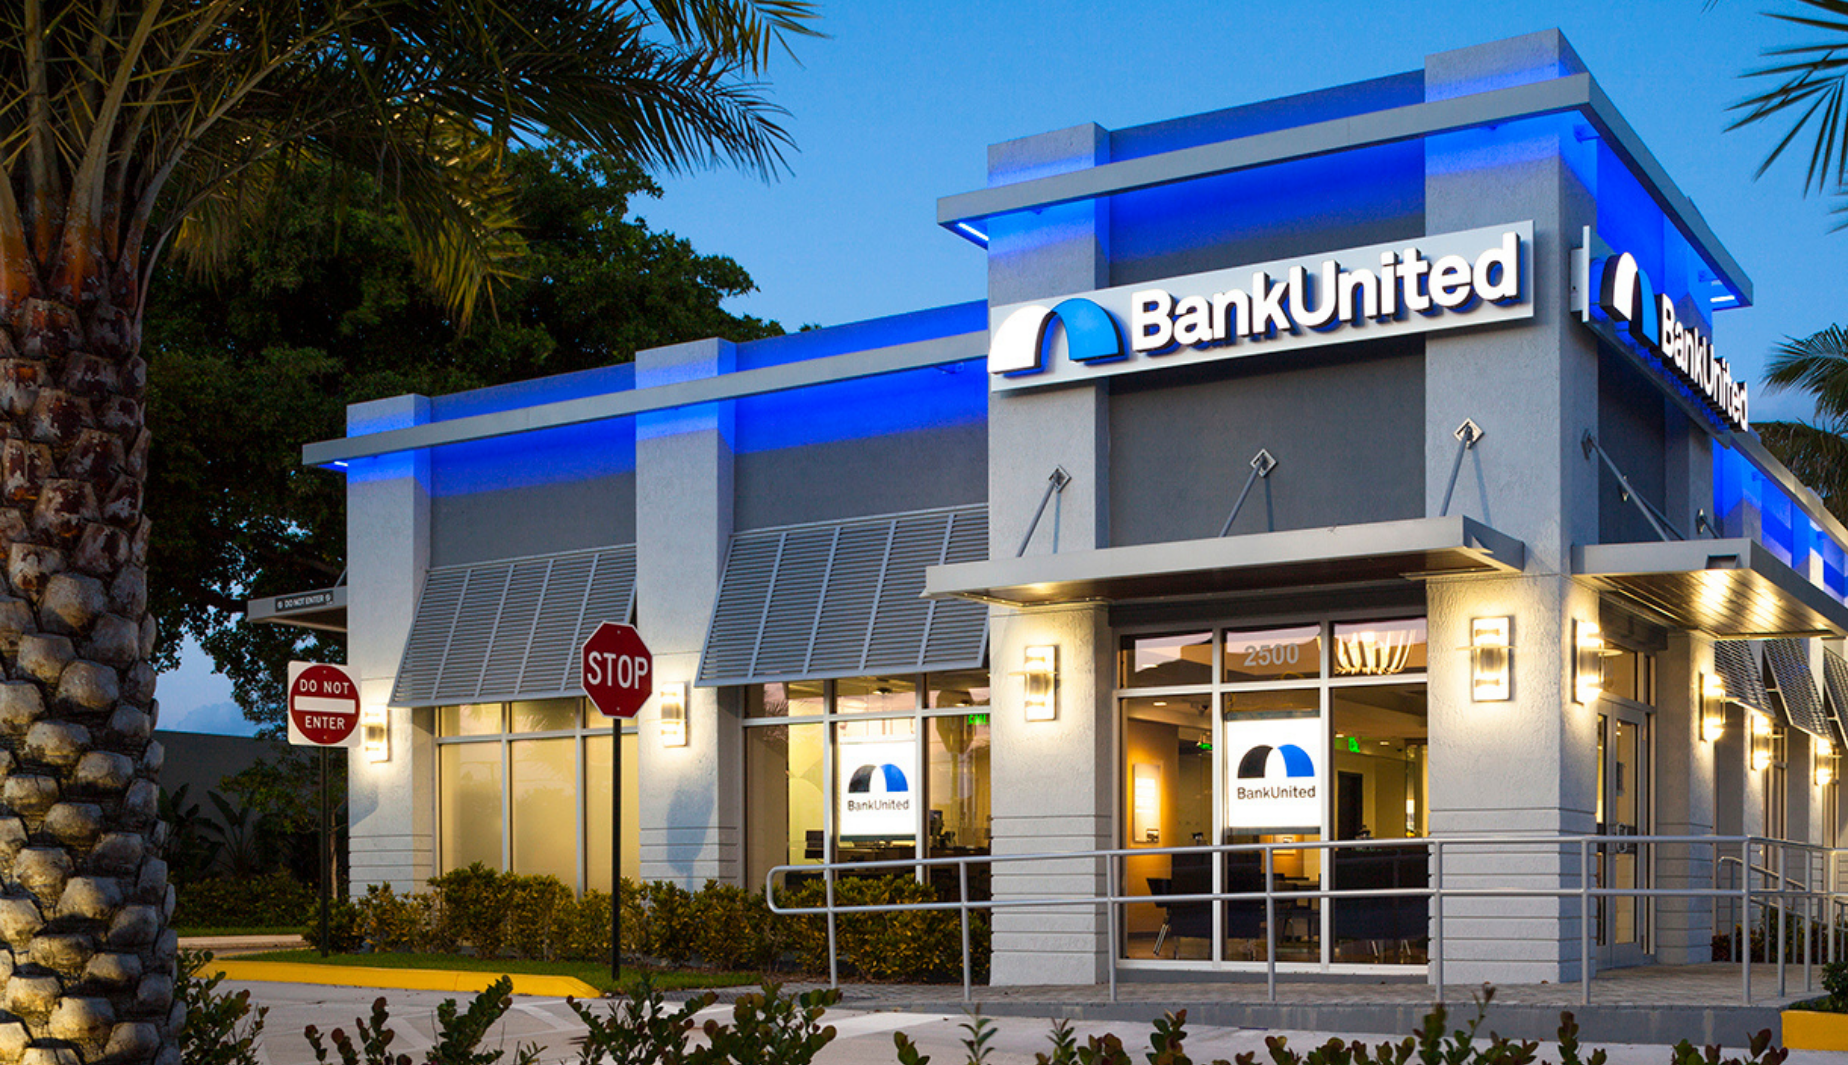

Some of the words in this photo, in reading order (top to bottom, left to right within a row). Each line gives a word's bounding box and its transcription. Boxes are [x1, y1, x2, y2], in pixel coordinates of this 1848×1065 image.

[1131, 231, 1520, 352] BankUnited
[1661, 292, 1749, 432] BankUnited
[284, 599, 293, 608] DO
[294, 597, 305, 607] NOT
[305, 594, 325, 605] ENTER
[1243, 643, 1300, 667] 2500
[587, 651, 649, 690] STOP
[299, 679, 318, 693] DO
[323, 681, 350, 695] NOT
[305, 715, 346, 731] ENTER
[1237, 785, 1316, 800] BankUnited
[847, 799, 910, 812] BankUnited
